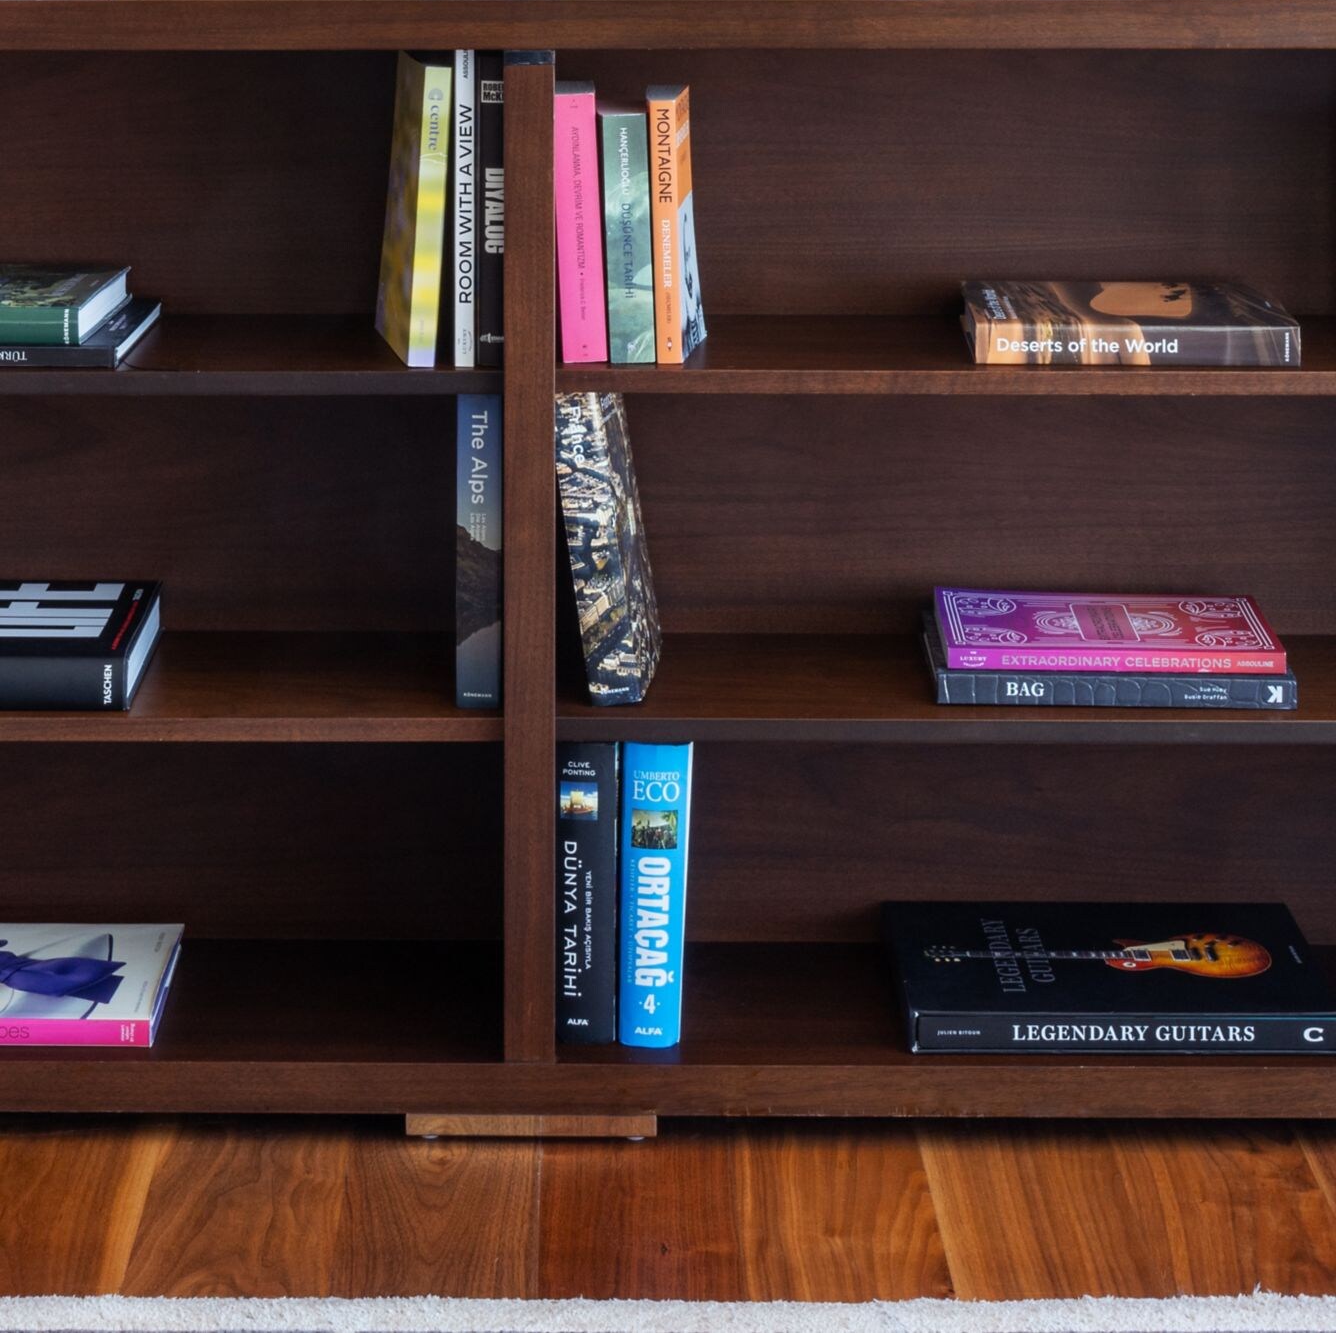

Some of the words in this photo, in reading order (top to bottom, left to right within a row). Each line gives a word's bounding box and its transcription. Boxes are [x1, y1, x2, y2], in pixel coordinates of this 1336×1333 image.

[428, 105, 439, 151] centre
[459, 104, 472, 159] VIEW
[459, 163, 472, 176] A
[657, 109, 672, 203] MONTAIGNE
[459, 182, 472, 235] WITH
[459, 241, 472, 304] ROOM
[661, 219, 673, 288] DENEMELER
[996, 337, 1062, 353] Deserts
[1067, 337, 1088, 353] of
[1091, 338, 1120, 353] the
[1125, 339, 1179, 354] World
[472, 410, 488, 449] The
[469, 456, 488, 504] Alps
[1001, 655, 1120, 667] EXTRAORDINARY
[1125, 657, 1232, 669] CELEBRATIONS
[103, 665, 112, 705] TASCHEN
[1006, 682, 1045, 697] BAG
[562, 768, 597, 777] PONTING
[567, 761, 591, 769] CLIVE
[633, 770, 680, 782] UMBERTO
[632, 780, 681, 803] ECO
[564, 841, 582, 914] DÜNYA
[634, 856, 674, 988] ORTAÇAĞ
[564, 924, 582, 997] TARİHİ
[567, 1018, 589, 1026] ALFA
[635, 1027, 663, 1036] ALFA
[1012, 1025, 1149, 1041] LEGENDARY
[1155, 1025, 1256, 1042] GUITARS
